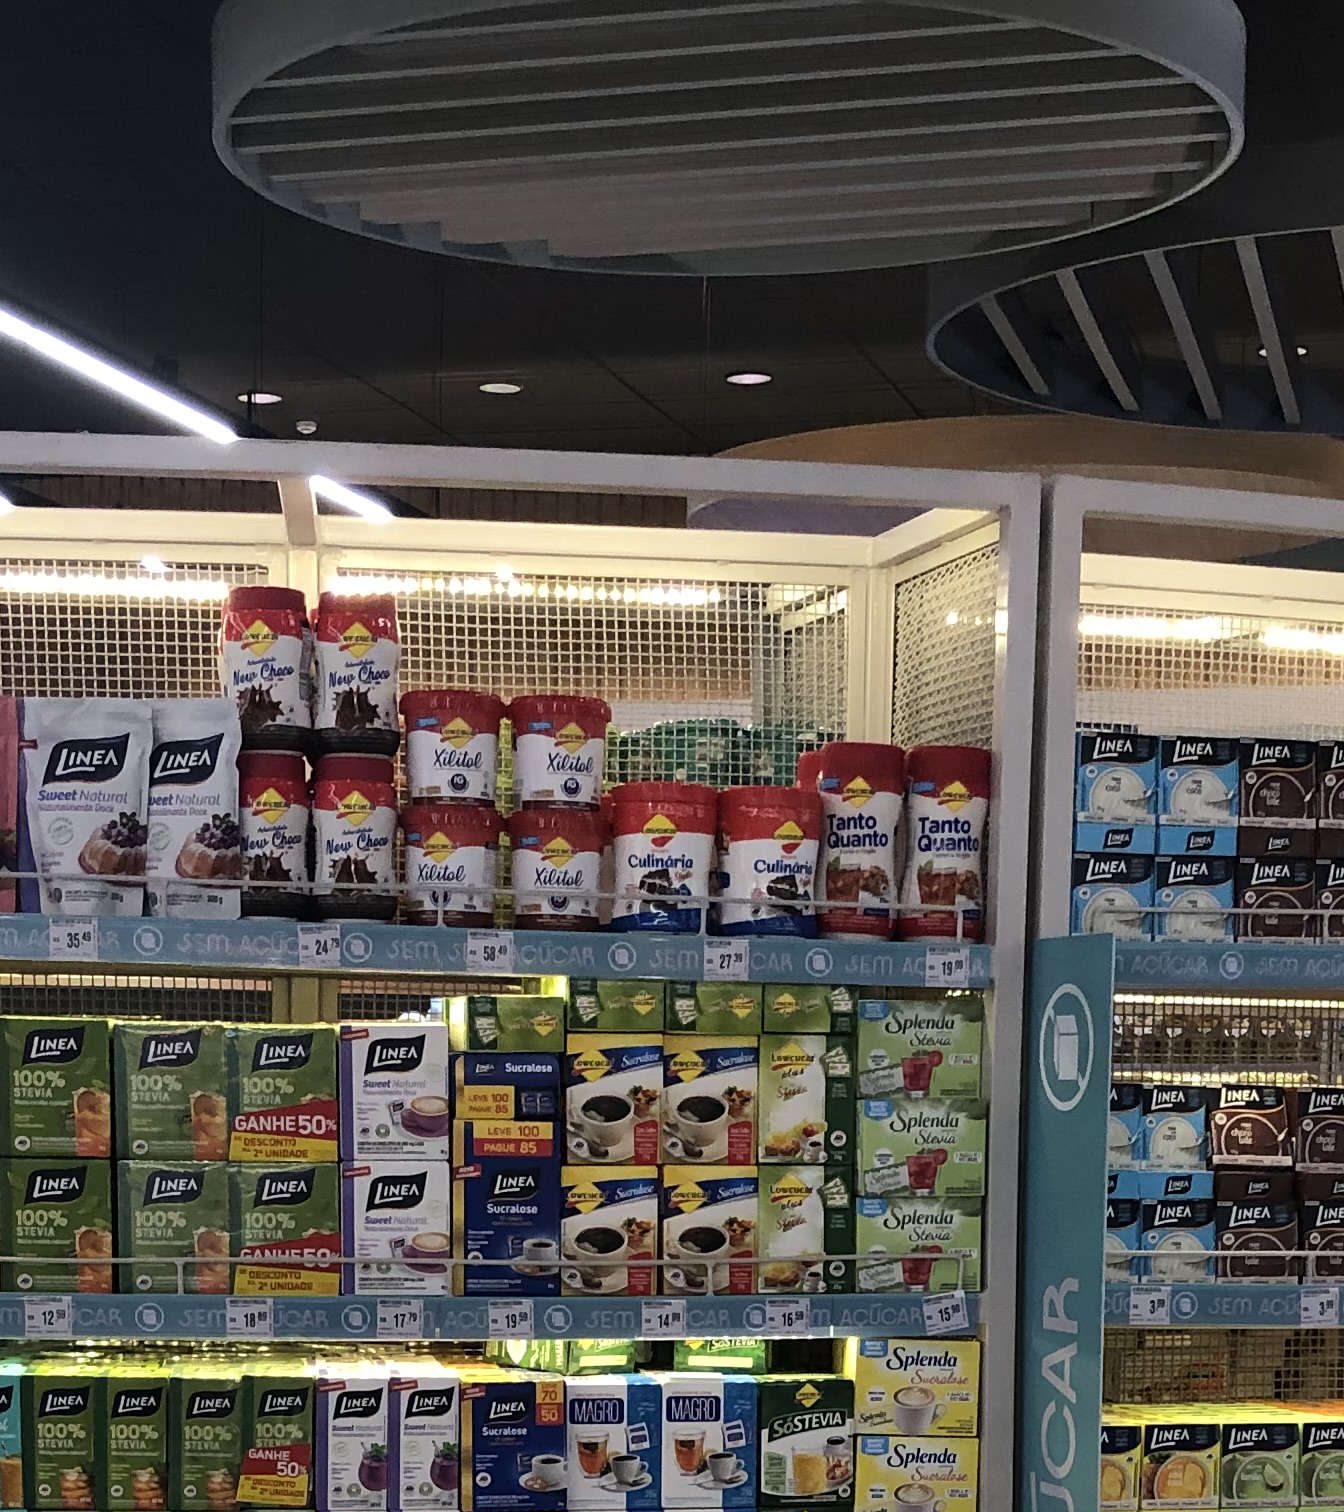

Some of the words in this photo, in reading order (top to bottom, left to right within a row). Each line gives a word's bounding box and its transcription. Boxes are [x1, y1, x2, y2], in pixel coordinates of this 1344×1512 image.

[1093, 739, 1132, 759] LINEA
[1251, 744, 1290, 765] LINEA
[55, 750, 116, 775] LINEA
[154, 748, 213, 775] LINEA
[433, 748, 483, 771] Xilitol
[37, 789, 77, 802] Sweet
[79, 788, 129, 805] Natural
[826, 813, 878, 831] Tanto
[826, 828, 889, 850] Quanto
[627, 853, 694, 870] Culinária
[885, 1012, 955, 1034] Splenda
[29, 1034, 78, 1059] LINEA
[910, 1034, 952, 1048] Stevia
[259, 1042, 306, 1066] LINEA
[373, 1045, 418, 1067] LINEA
[505, 1062, 553, 1074] Sucralose
[13, 1070, 65, 1088] 100%
[1220, 1087, 1259, 1107] LINEA
[235, 1116, 296, 1133] GANHE
[298, 1115, 337, 1134] 50%
[488, 1126, 511, 1137] LEVE
[517, 1125, 540, 1137] 100
[889, 1111, 959, 1133] Splenda
[243, 1137, 297, 1147] DESCONTO
[484, 1142, 516, 1153] PAGUE
[520, 1142, 537, 1154] 85
[264, 1148, 308, 1158] UNIDADE
[494, 1174, 535, 1196] LINEA
[887, 1348, 957, 1371] Splenda
[911, 1371, 969, 1386] Sucralose
[542, 1389, 558, 1402] 70
[490, 1400, 526, 1420] LINEA
[542, 1409, 558, 1422] 50
[574, 1400, 619, 1423] MAGRO
[482, 1426, 528, 1437] Sucralose
